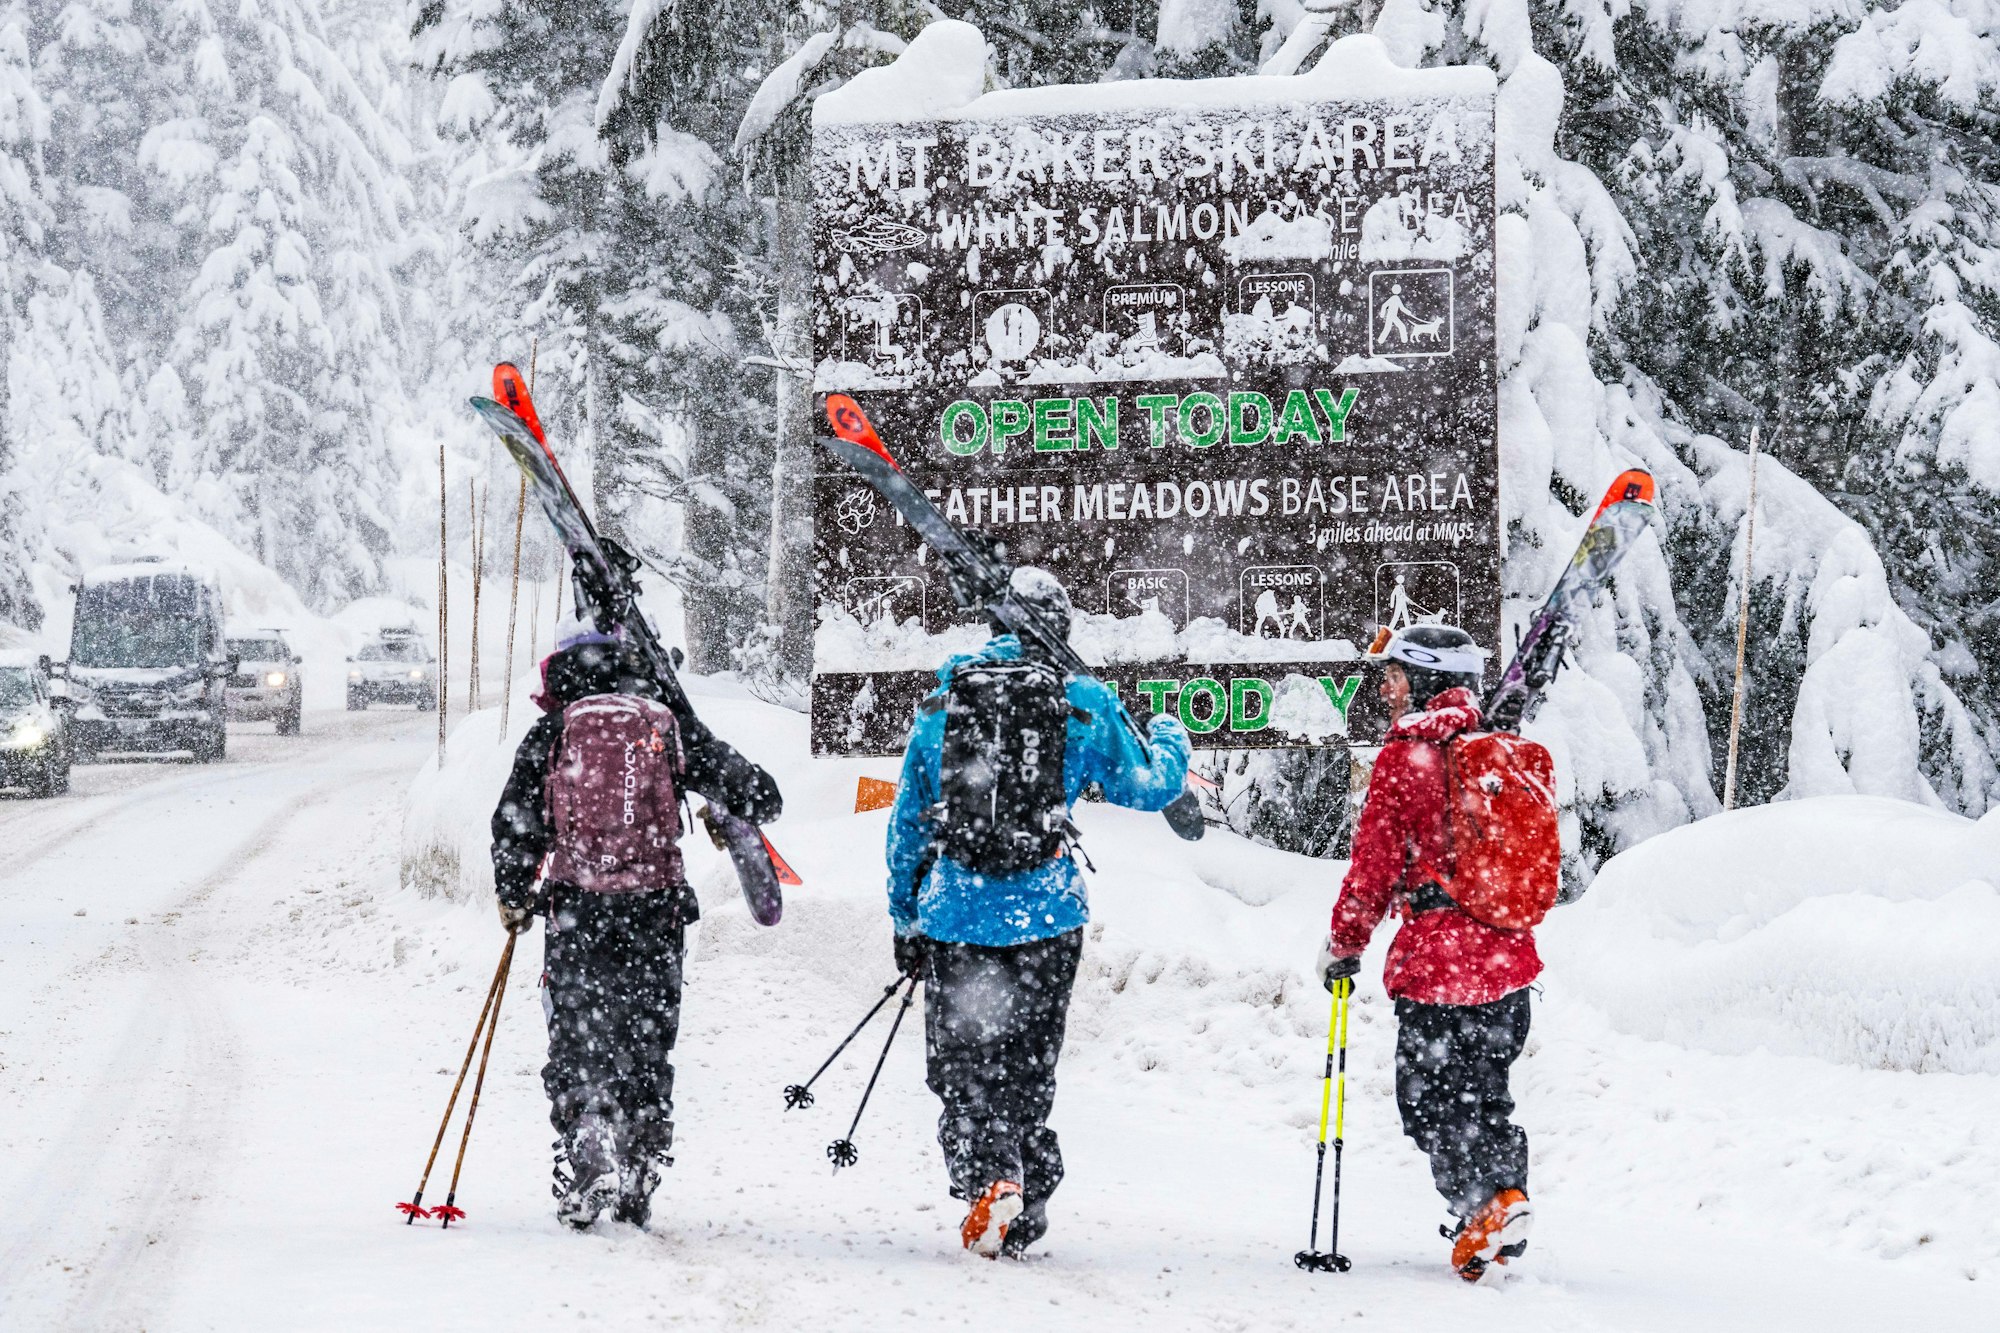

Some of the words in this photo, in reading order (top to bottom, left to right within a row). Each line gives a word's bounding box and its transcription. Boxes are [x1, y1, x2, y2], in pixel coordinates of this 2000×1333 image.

[848, 137, 948, 190] MT.
[968, 129, 1172, 187] BAKER
[1184, 121, 1274, 177] SKI
[1294, 112, 1463, 172] AREA
[938, 209, 1064, 249] WHITE
[1079, 201, 1248, 245] SALMON
[1400, 191, 1472, 232] REA
[1111, 291, 1177, 306] PREMIUM
[1249, 280, 1306, 294] LESSONS
[940, 396, 1119, 456] OPEN
[1136, 387, 1360, 449] TODAY
[1073, 478, 1270, 521] MEADOWS
[1282, 475, 1368, 515] BASE
[1381, 472, 1475, 511] AREA
[1306, 523, 1317, 544] 3
[1320, 521, 1361, 544] miles
[1364, 520, 1414, 542] ahead
[1416, 525, 1431, 541] at
[1432, 522, 1475, 541] MM55
[1127, 576, 1168, 590] BASIC
[1250, 573, 1313, 587] LESSONS
[1137, 676, 1363, 733] TODY
